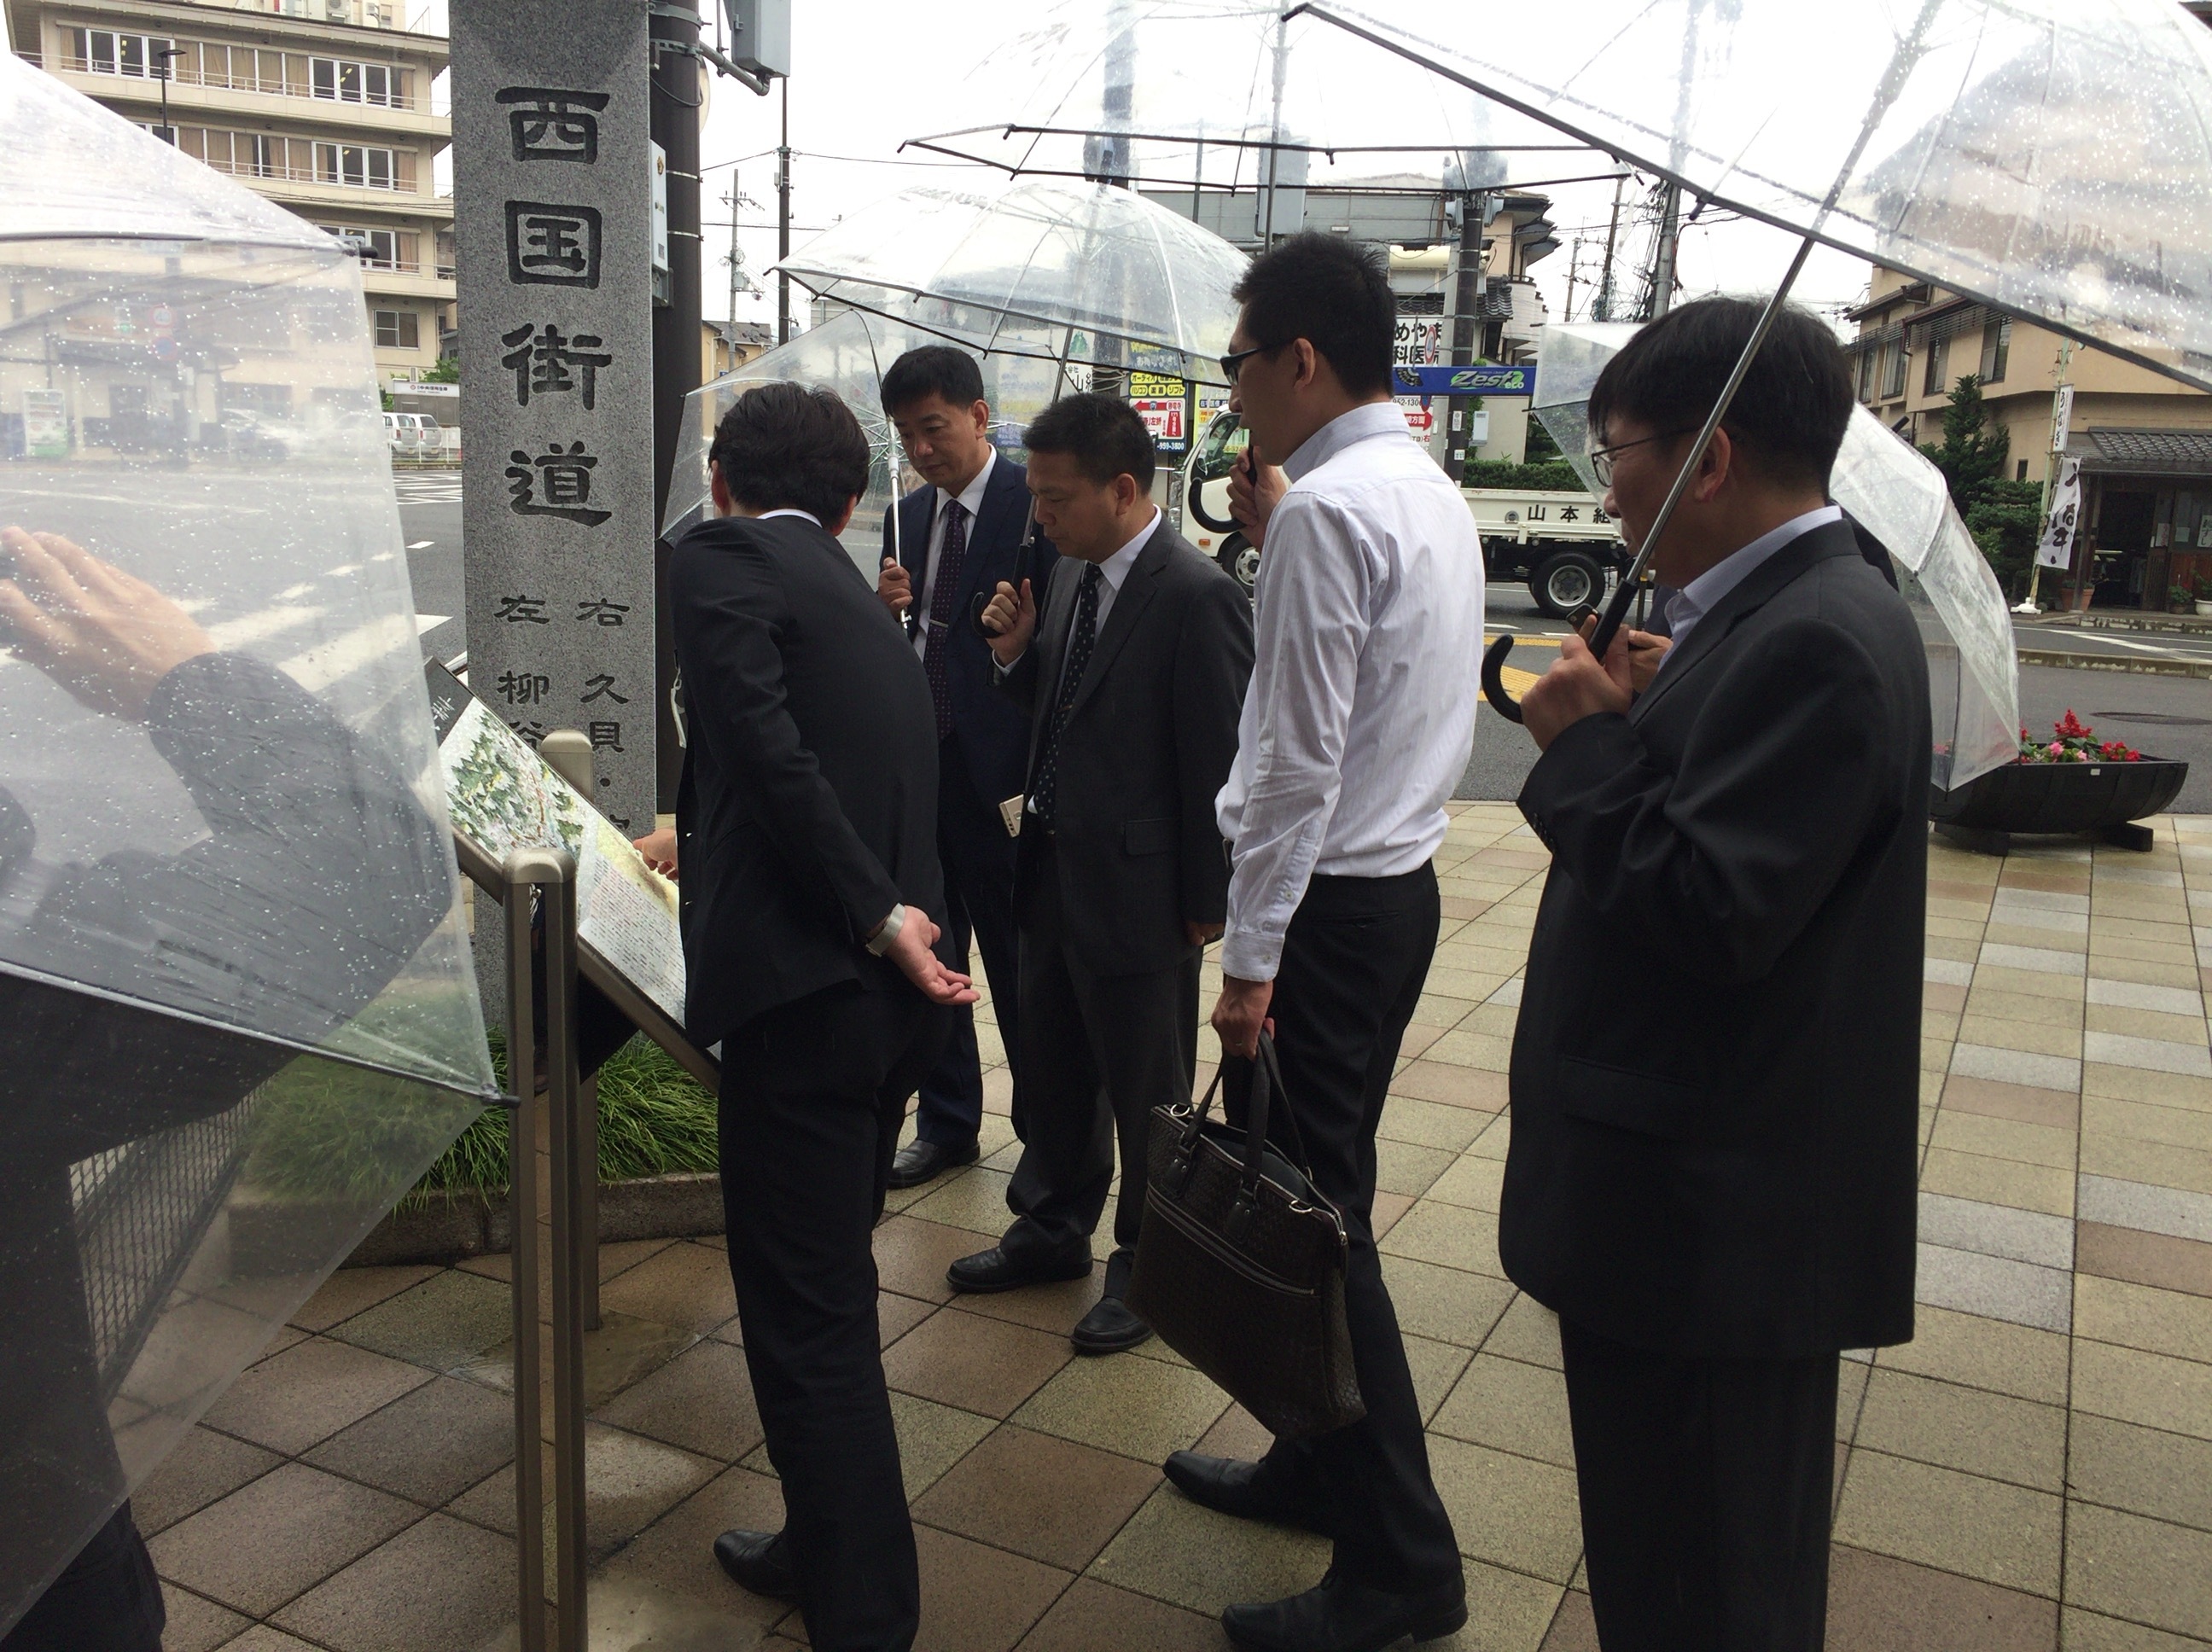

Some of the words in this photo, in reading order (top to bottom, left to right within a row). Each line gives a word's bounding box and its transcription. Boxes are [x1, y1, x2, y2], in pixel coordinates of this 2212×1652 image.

[495, 86, 612, 527] 西国街道
[493, 595, 550, 624] 左
[576, 598, 630, 627] 右
